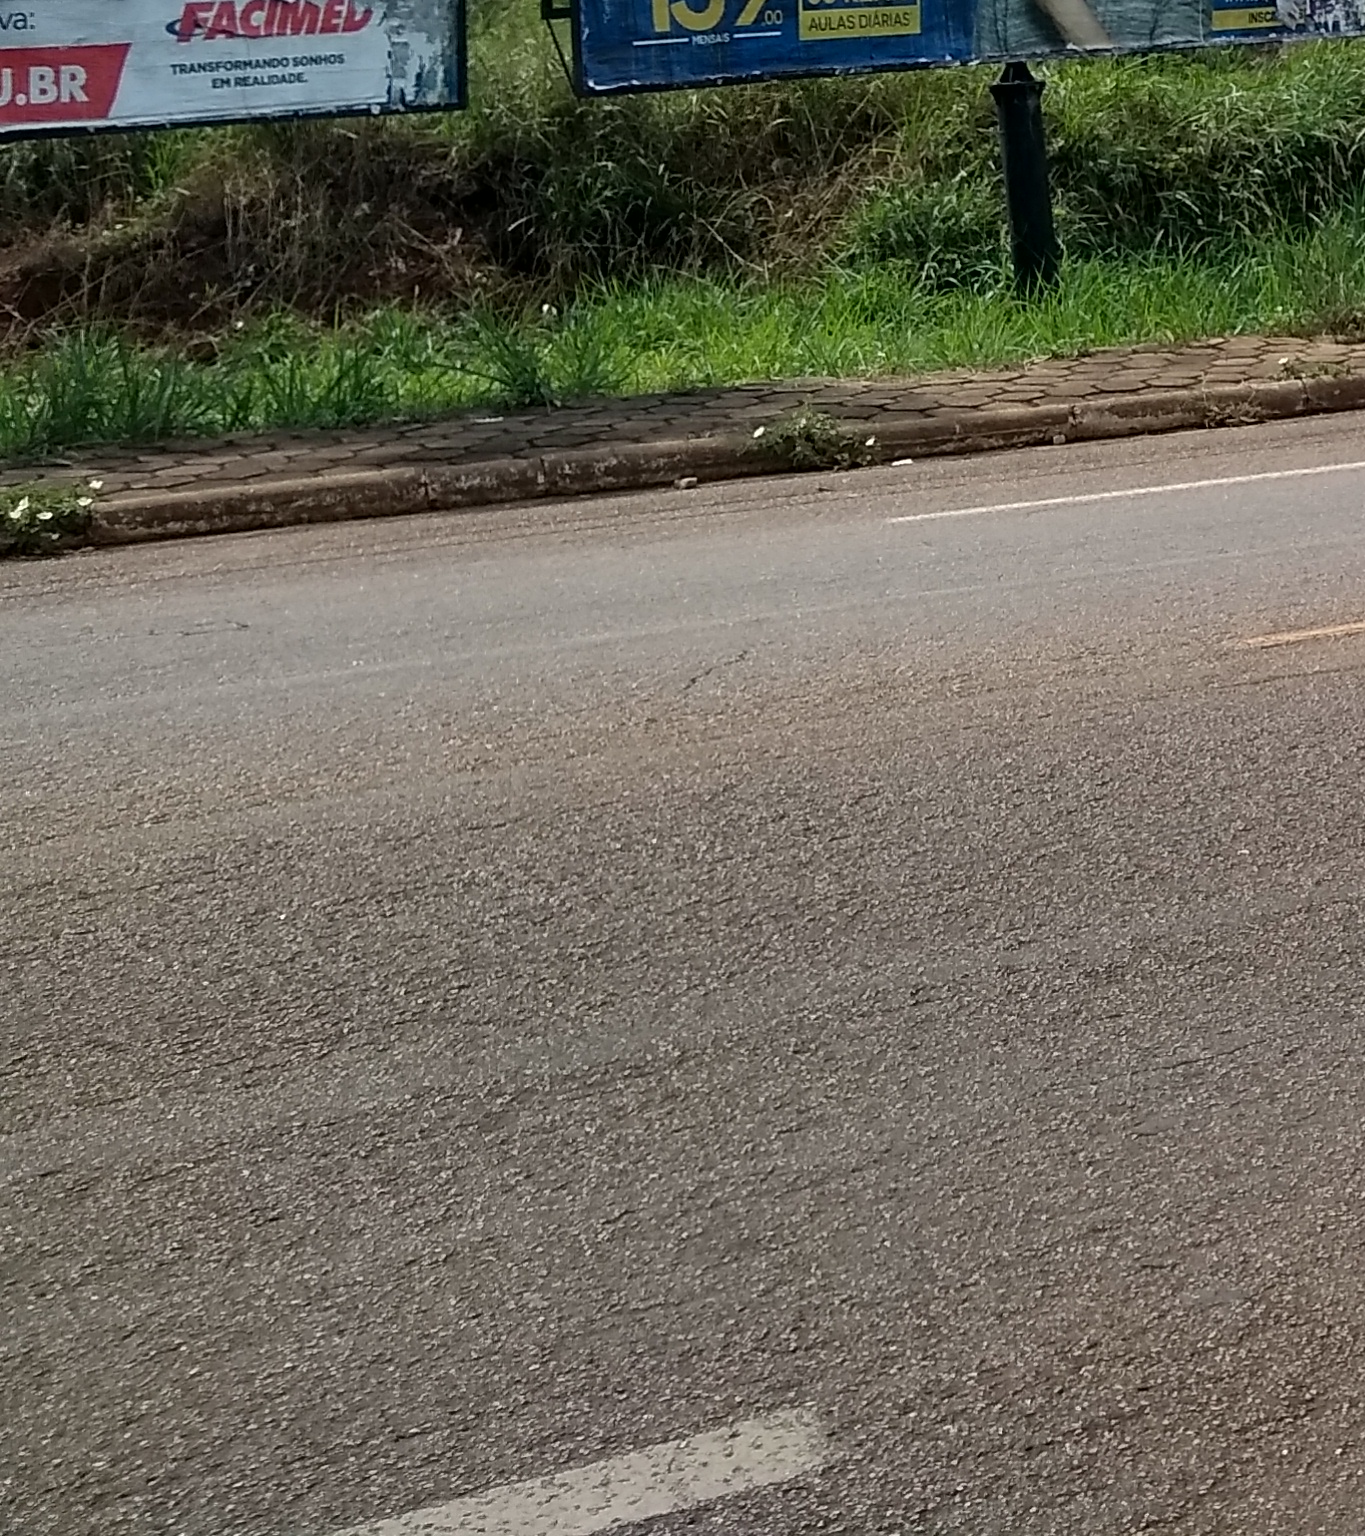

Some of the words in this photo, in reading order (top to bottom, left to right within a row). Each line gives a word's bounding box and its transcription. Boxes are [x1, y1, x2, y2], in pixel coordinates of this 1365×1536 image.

[809, 14, 856, 31] AULAS
[170, 56, 291, 75] TRANSFORMANDO
[292, 54, 346, 68] SONHOS
[211, 77, 232, 89] EM
